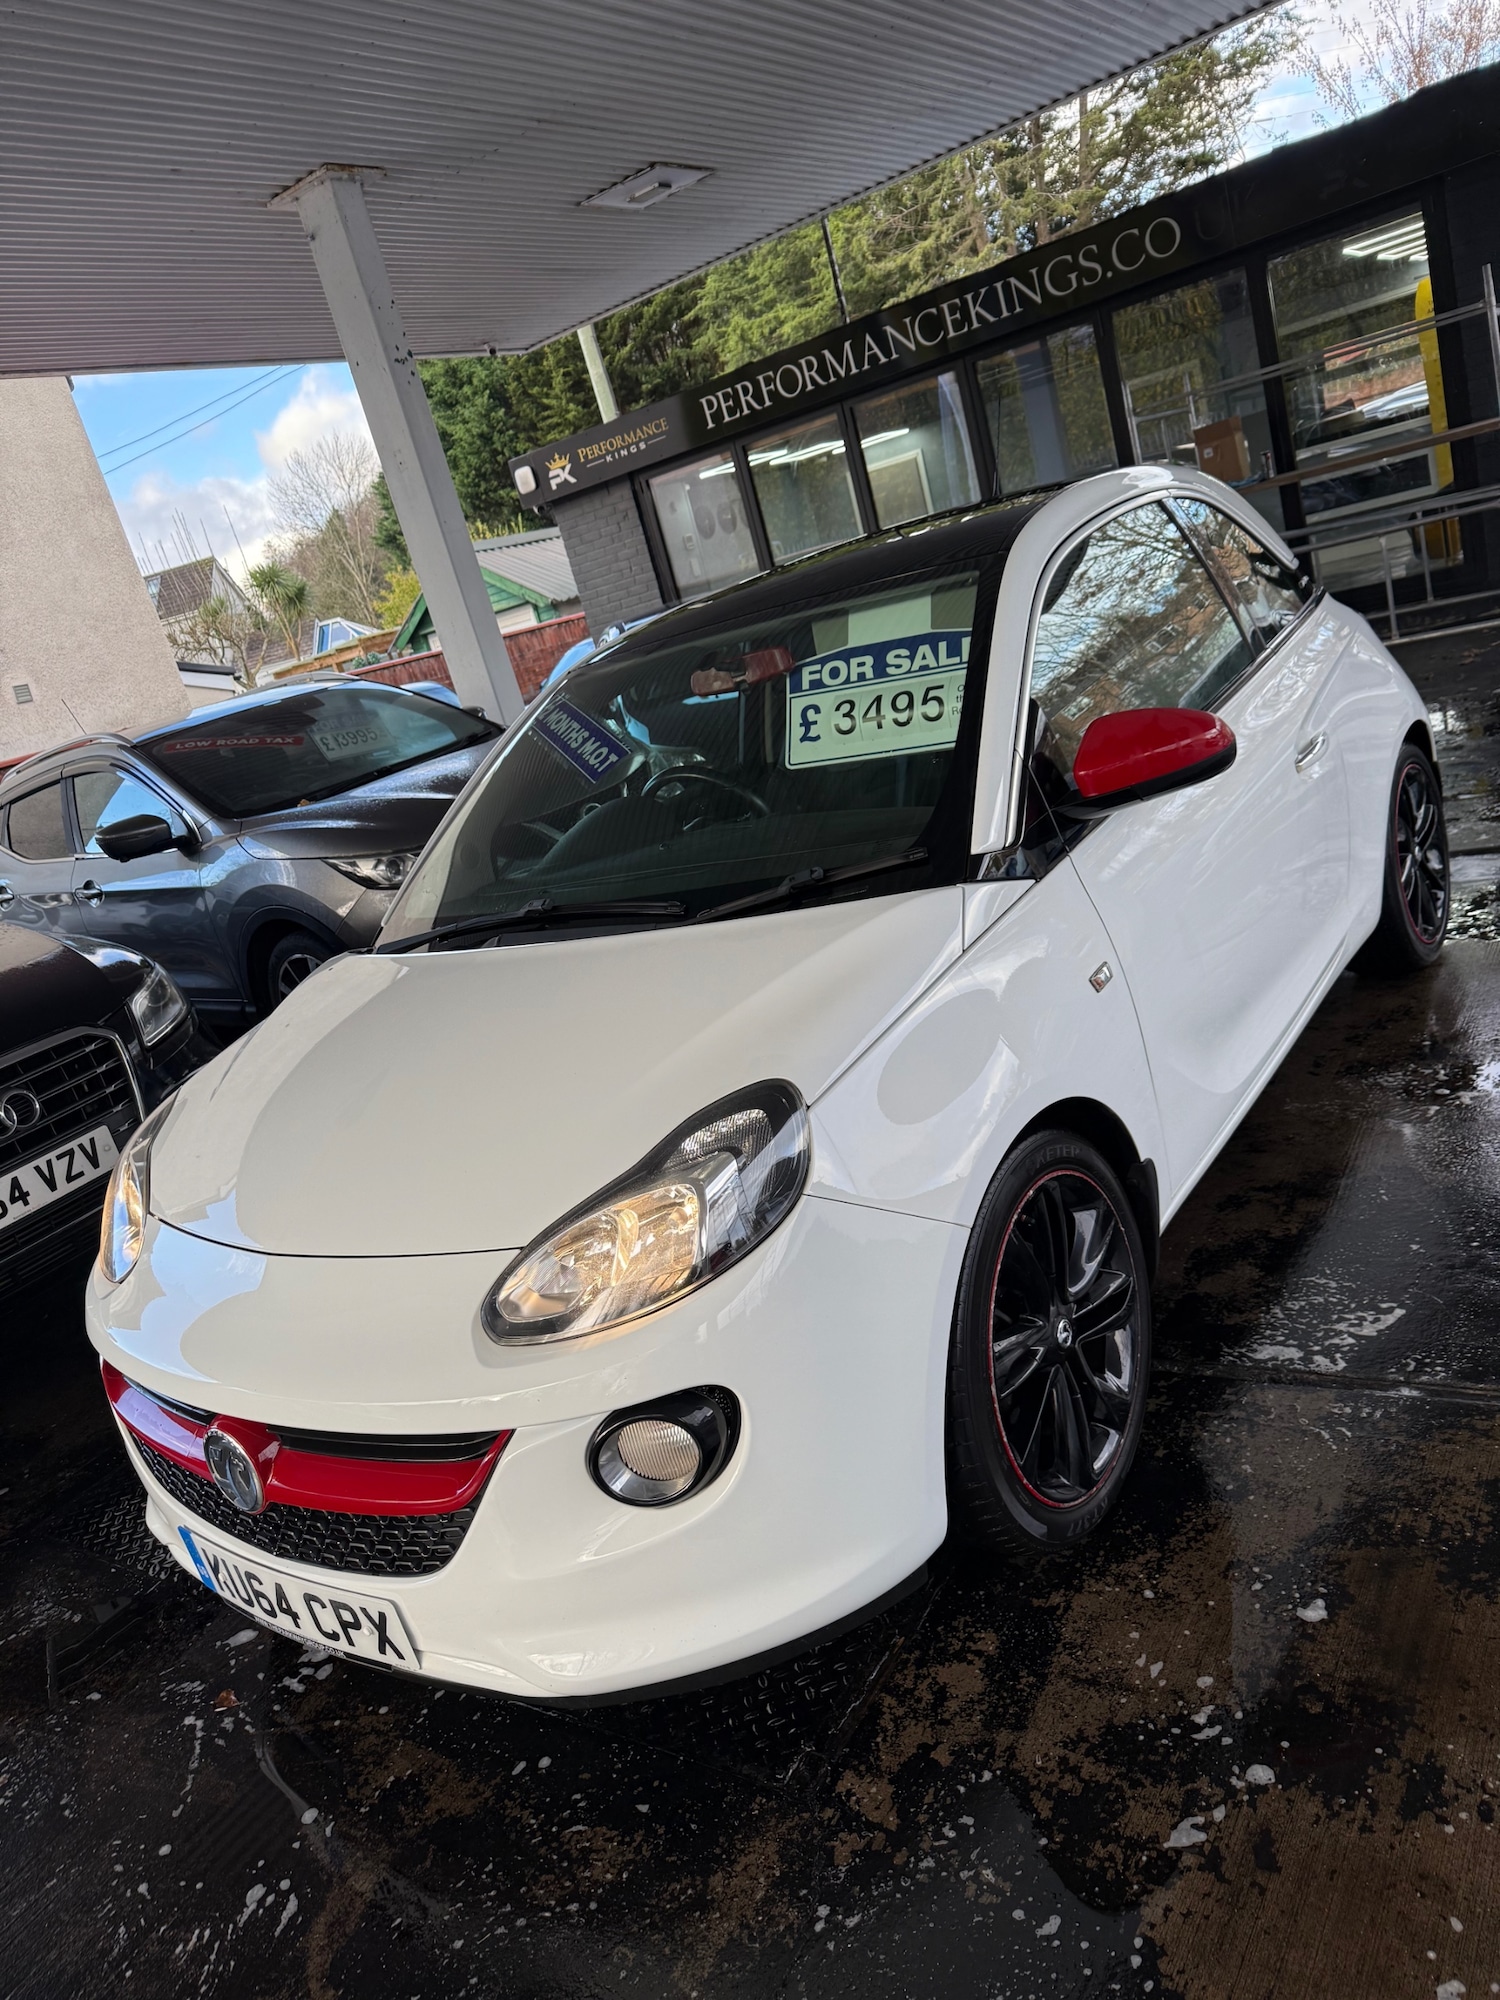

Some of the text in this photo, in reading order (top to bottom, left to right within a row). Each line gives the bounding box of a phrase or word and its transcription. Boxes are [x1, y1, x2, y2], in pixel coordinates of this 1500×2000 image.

[578, 417, 669, 462] PERFORMANCE
[606, 443, 646, 463] KINGS
[801, 655, 875, 690] FOR
[175, 736, 296, 750] LOW ROAD TAX
[543, 708, 590, 749] MONTHS
[34, 1138, 100, 1191] VZV
[202, 1547, 301, 1629] KU64
[303, 1591, 406, 1662] CPX
